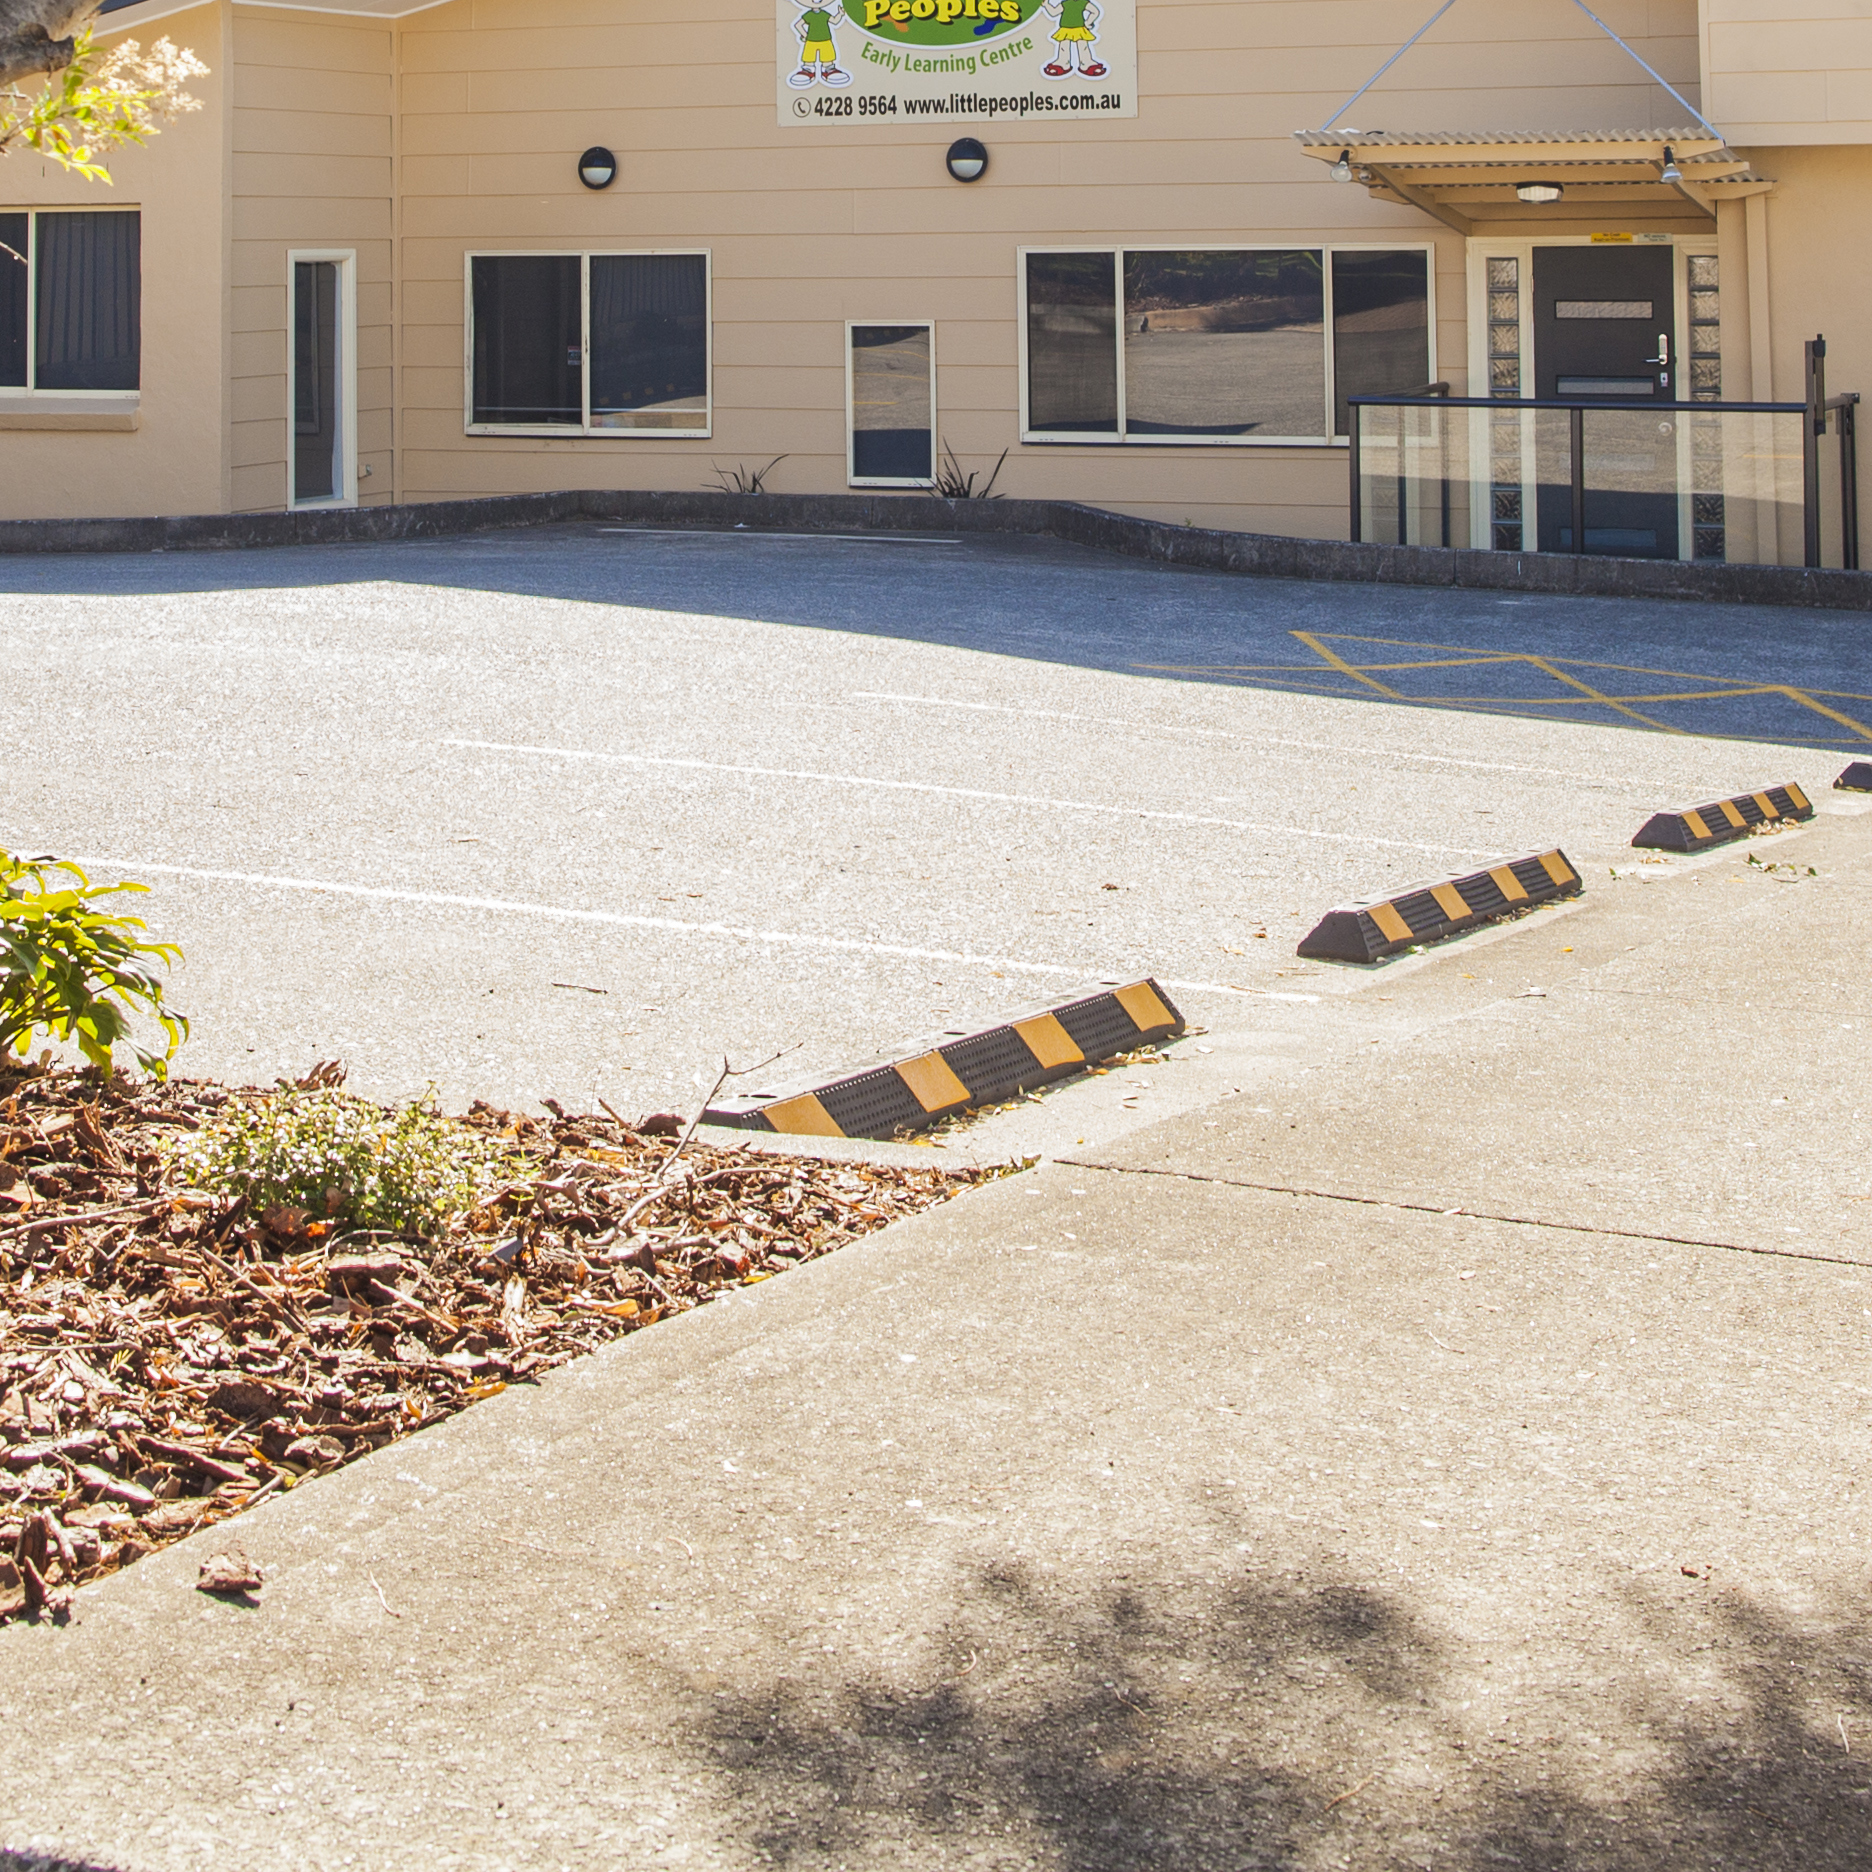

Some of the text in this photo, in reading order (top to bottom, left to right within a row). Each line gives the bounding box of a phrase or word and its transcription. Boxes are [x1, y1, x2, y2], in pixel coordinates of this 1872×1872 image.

[861, 37, 1034, 75] Early Learning Centre
[814, 91, 1121, 117] 4228 9564 www.littlepeoples.com.au
